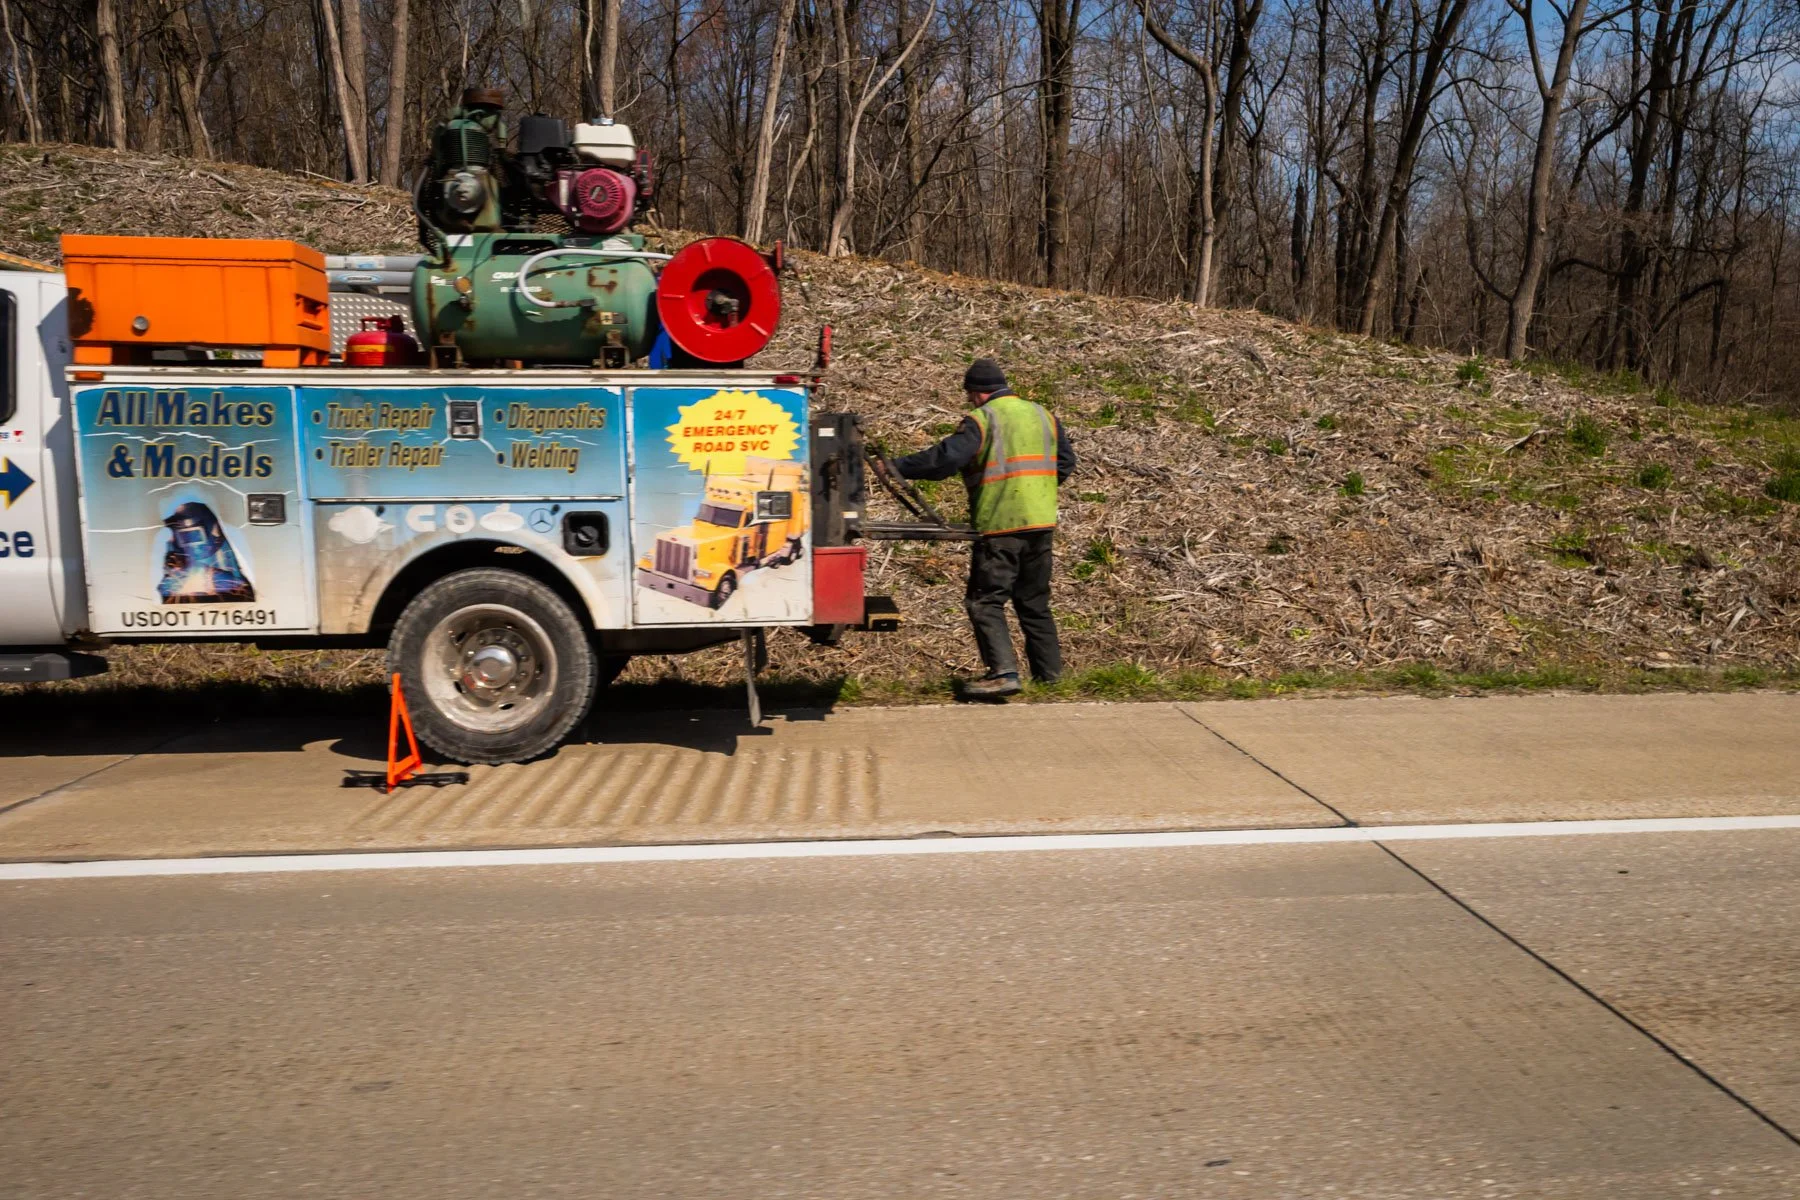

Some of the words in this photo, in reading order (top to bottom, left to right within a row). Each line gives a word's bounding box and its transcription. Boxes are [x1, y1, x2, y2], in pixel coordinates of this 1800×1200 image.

[97, 391, 148, 426] All
[153, 391, 275, 426] Makes
[326, 402, 376, 429] Truck
[378, 402, 436, 435] Repair
[507, 402, 607, 434] Diagnostics
[683, 424, 779, 437] EMERGENCY
[107, 444, 136, 478] &
[142, 444, 273, 478] Models
[329, 441, 386, 467] Trailer
[387, 441, 445, 472] Repair
[511, 442, 580, 473] Welding
[692, 441, 736, 453] ROAD
[740, 440, 770, 451] SVC
[122, 611, 191, 627] USDOT
[198, 610, 277, 625] 1716491
